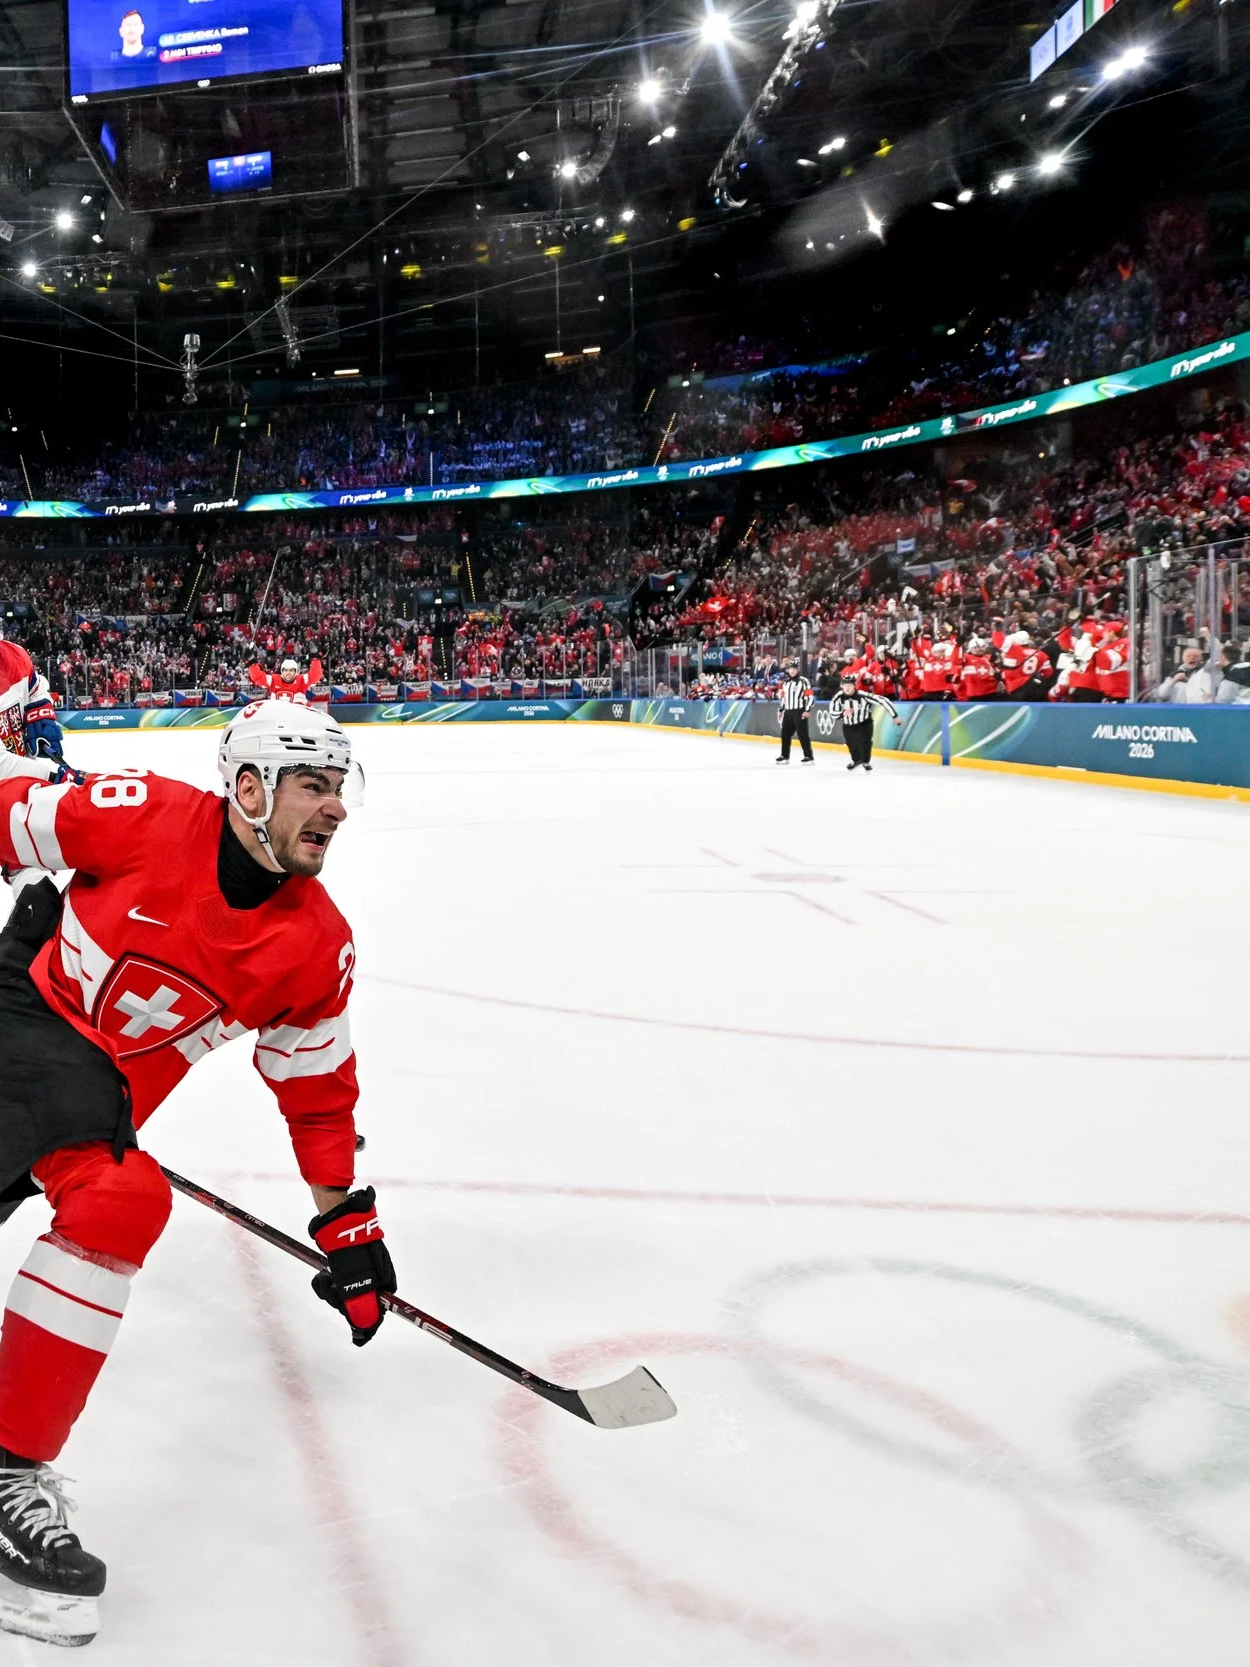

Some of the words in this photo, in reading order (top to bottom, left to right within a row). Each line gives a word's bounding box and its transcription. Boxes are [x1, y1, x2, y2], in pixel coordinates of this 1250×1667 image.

[1092, 724, 1140, 740] MILANO
[1142, 725, 1198, 743] CORTINA
[1129, 742, 1154, 758] 2026
[344, 1278, 372, 1292] TRUE
